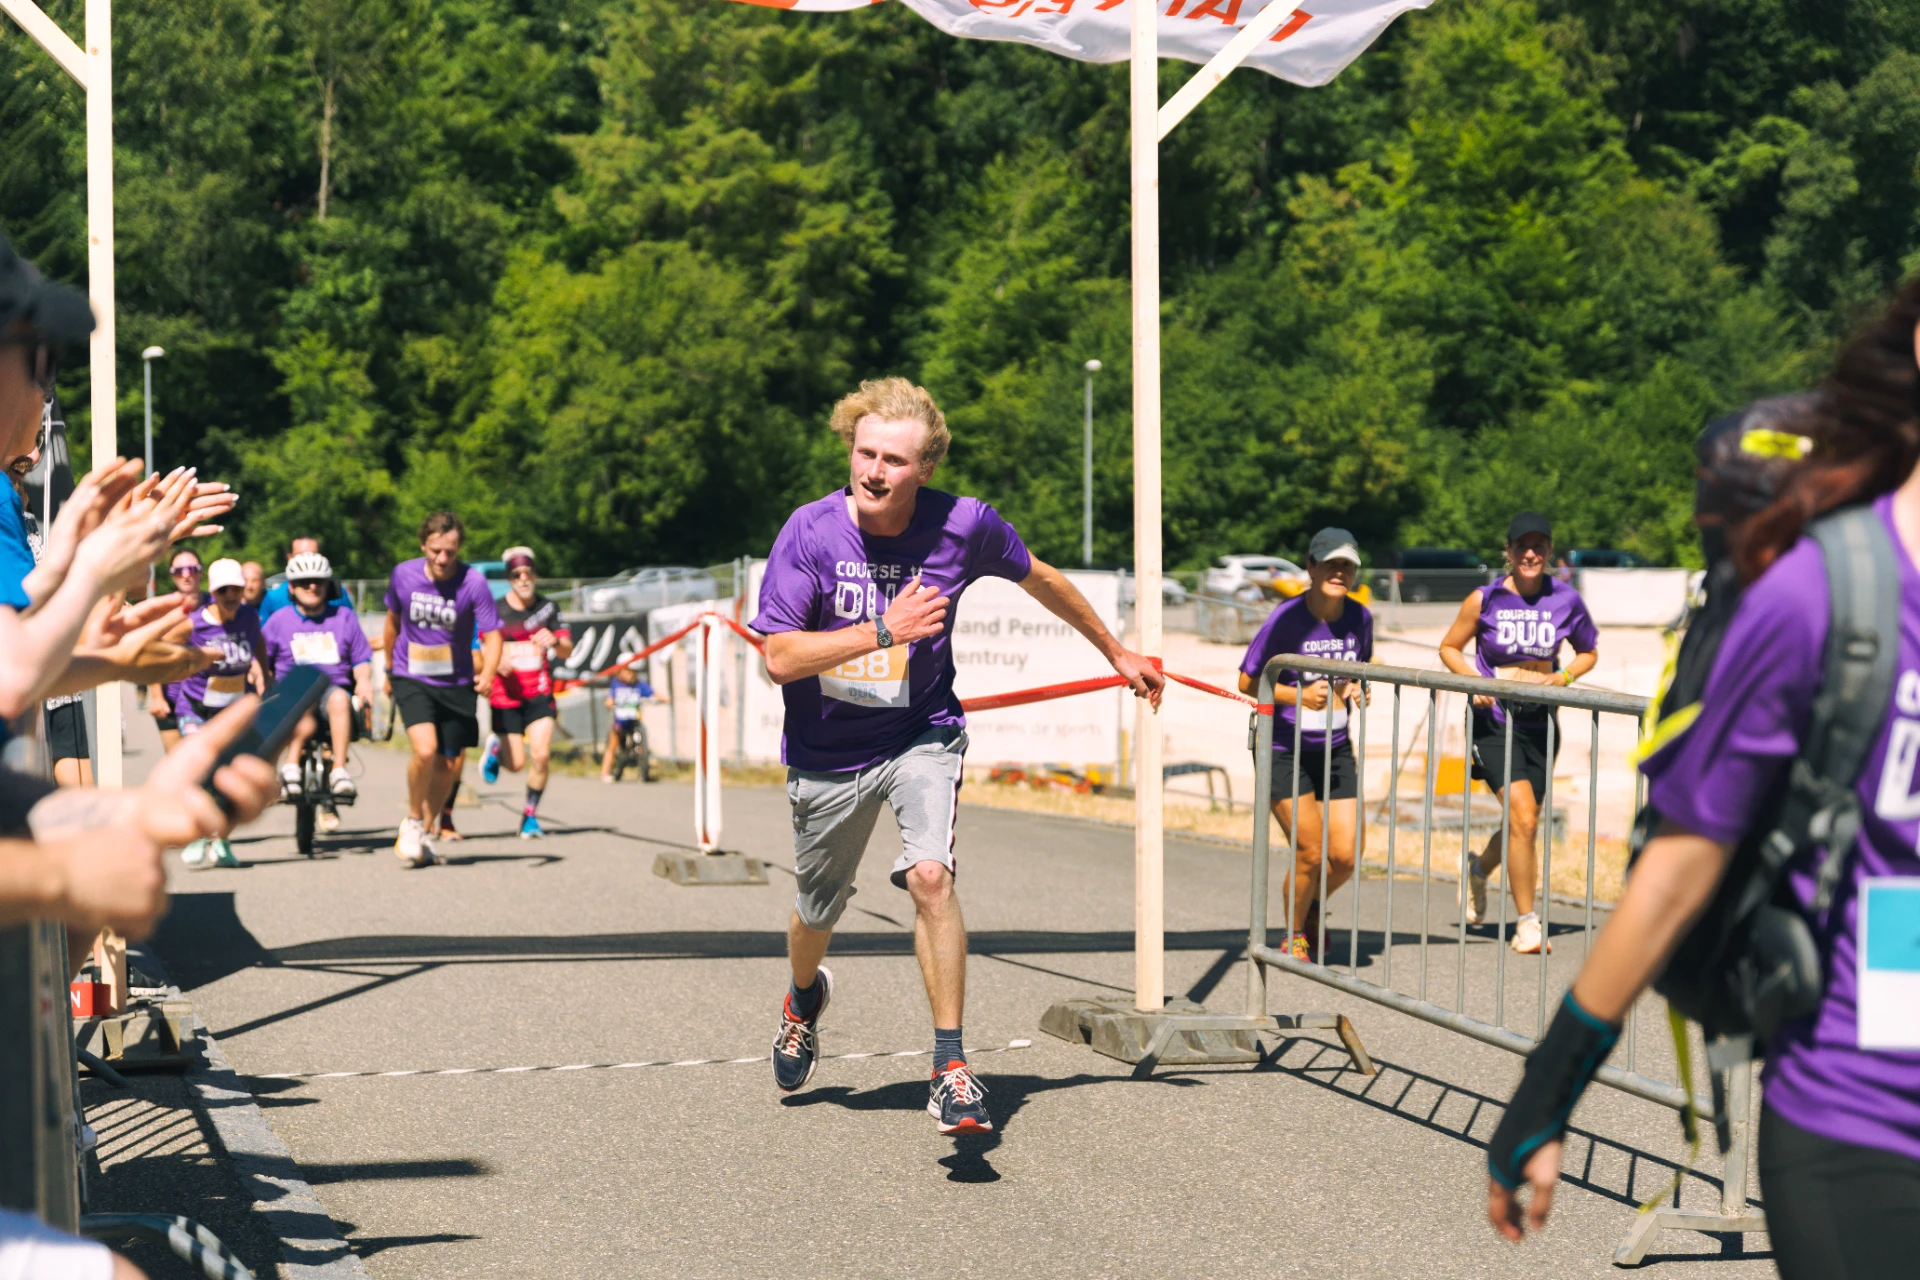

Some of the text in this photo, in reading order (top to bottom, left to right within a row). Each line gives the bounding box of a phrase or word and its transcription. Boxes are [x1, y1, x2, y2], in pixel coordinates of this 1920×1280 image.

[836, 561, 901, 579] COURSE
[834, 581, 926, 621] DU
[410, 601, 457, 626] DUO
[1496, 609, 1539, 621] COURSE
[1009, 618, 1074, 637] Perrin
[1496, 621, 1556, 648] DUO
[1303, 639, 1344, 652] COURSE
